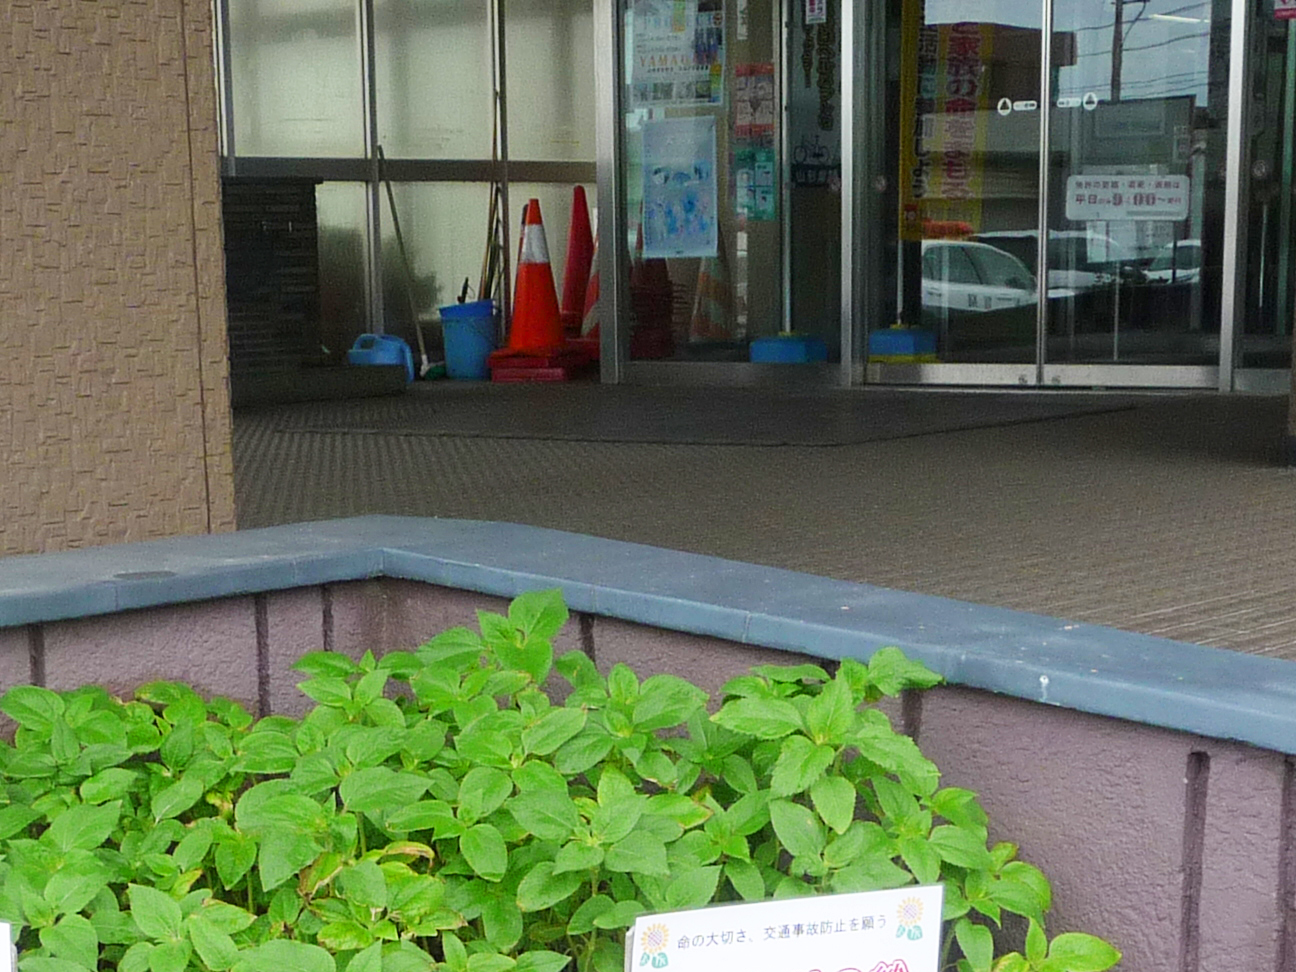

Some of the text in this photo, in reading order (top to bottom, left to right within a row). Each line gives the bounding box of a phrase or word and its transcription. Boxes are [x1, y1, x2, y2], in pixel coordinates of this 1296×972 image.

[677, 915, 886, 949] 命の大切さ、交通事故防止を願う
